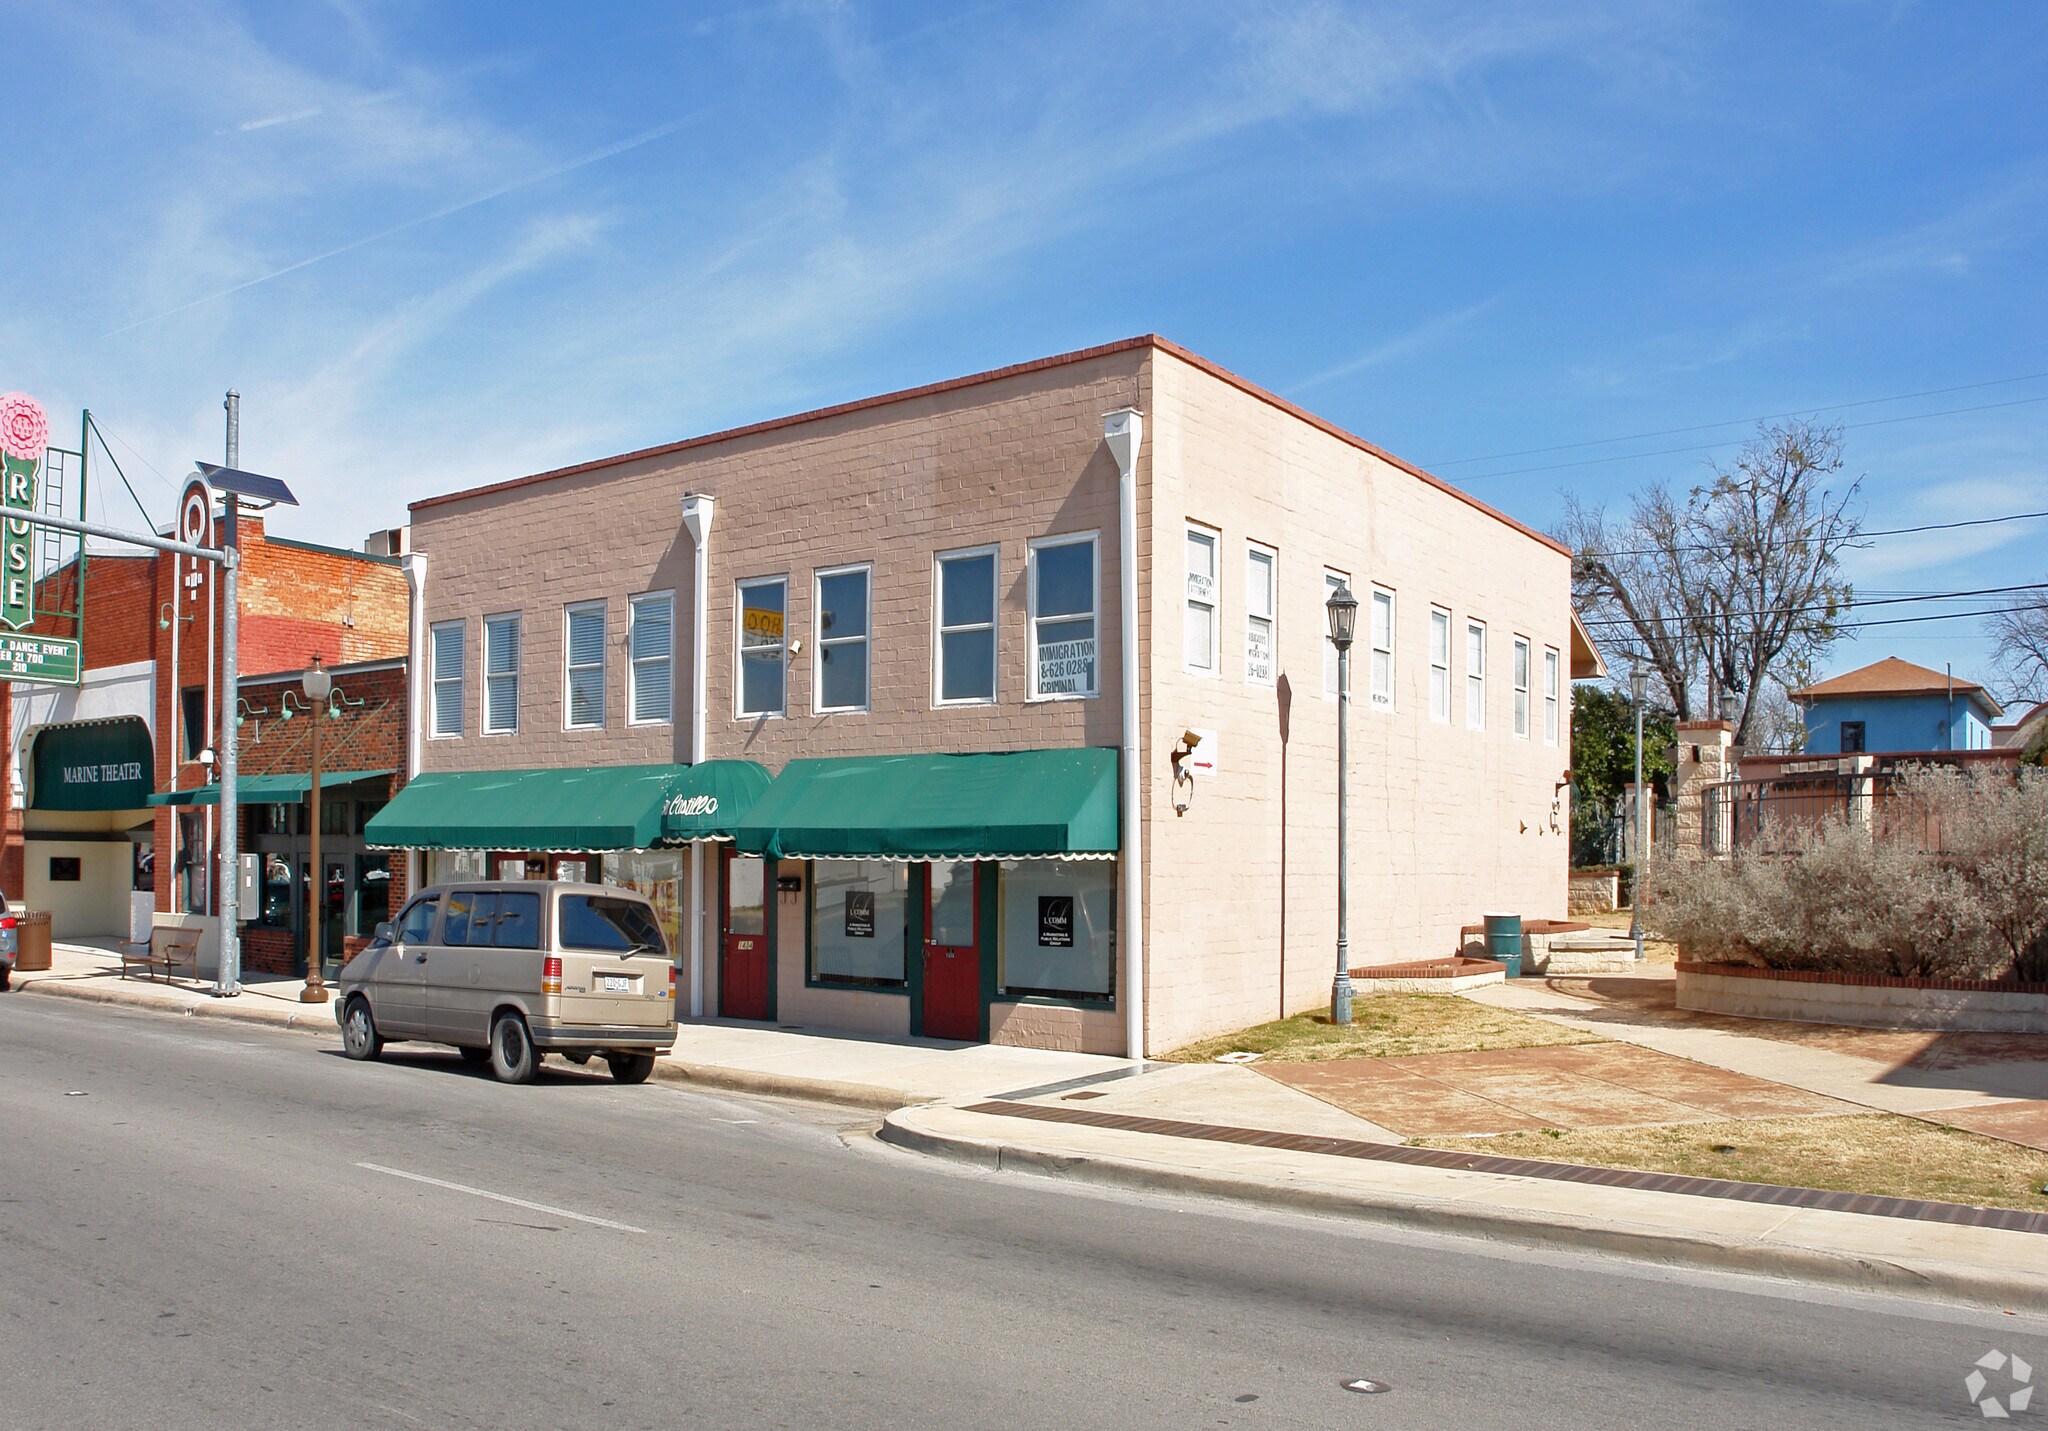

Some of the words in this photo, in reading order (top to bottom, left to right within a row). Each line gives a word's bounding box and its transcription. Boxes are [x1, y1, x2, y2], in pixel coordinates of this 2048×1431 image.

[9, 640, 39, 653] DANCE
[42, 643, 69, 656] EVENT
[1039, 640, 1095, 662] IMMIGRATION
[12, 661, 28, 673] 210
[27, 653, 44, 664] 700
[1049, 660, 1065, 678] 626
[1066, 658, 1088, 676] 0288
[1040, 679, 1079, 694] CRIMINAL
[63, 765, 99, 783] MARINE
[100, 762, 142, 782] THEATER
[669, 793, 719, 816] Castillo
